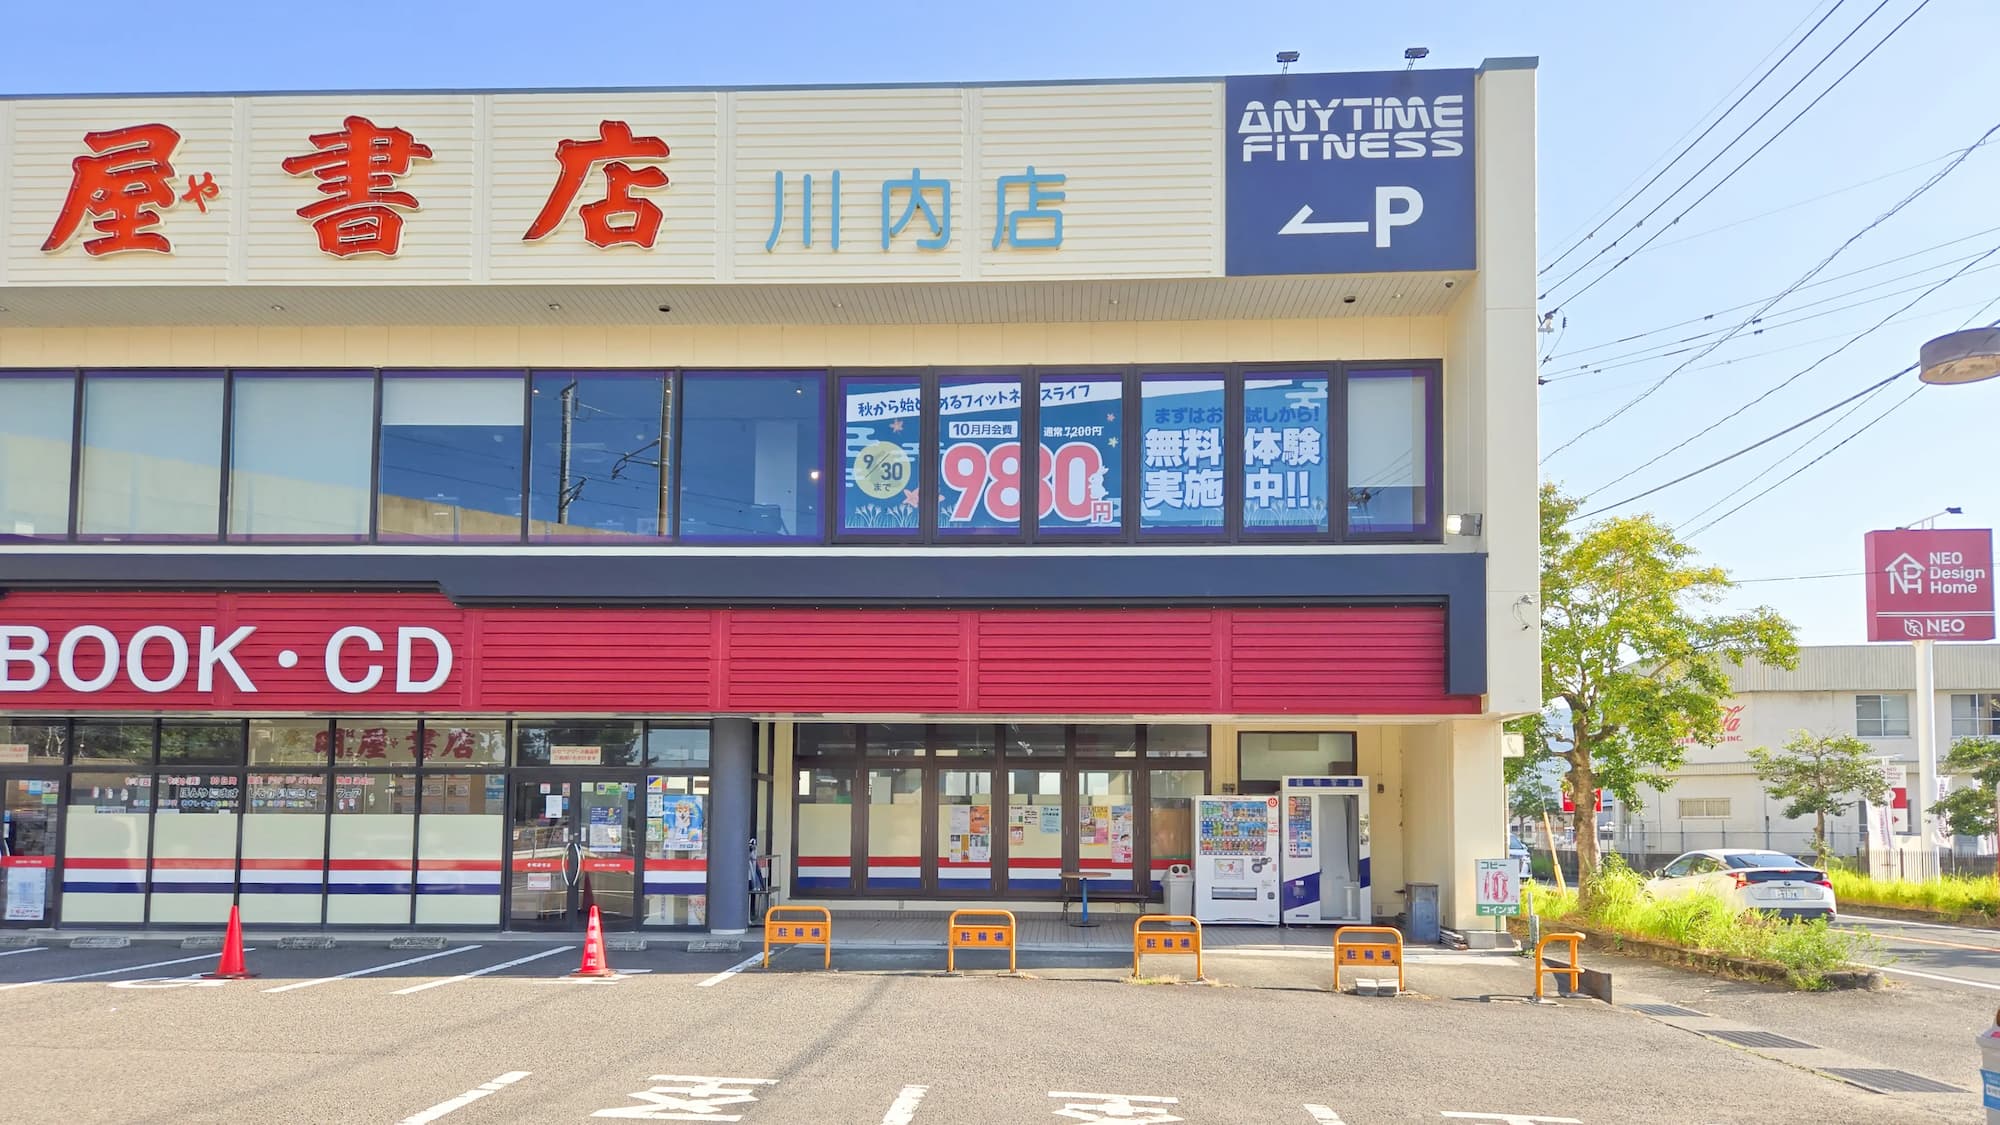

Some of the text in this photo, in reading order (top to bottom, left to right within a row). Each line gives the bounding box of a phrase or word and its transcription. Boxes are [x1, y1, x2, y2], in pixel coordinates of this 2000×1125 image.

[1238, 95, 1463, 133] ANYTIME
[1243, 130, 1463, 161] FITNESS
[766, 165, 1067, 251] 川内店
[1376, 186, 1424, 248] P
[1144, 427, 1321, 467] 無料体験
[1929, 552, 1963, 565] NEO
[1930, 566, 1985, 582] Design
[1930, 581, 1978, 594] Home
[1926, 619, 1966, 633] NEO
[0, 625, 257, 692] BOOK
[325, 626, 453, 693] CD
[1480, 861, 1507, 870] コピー
[1481, 905, 1518, 914] コイン式
